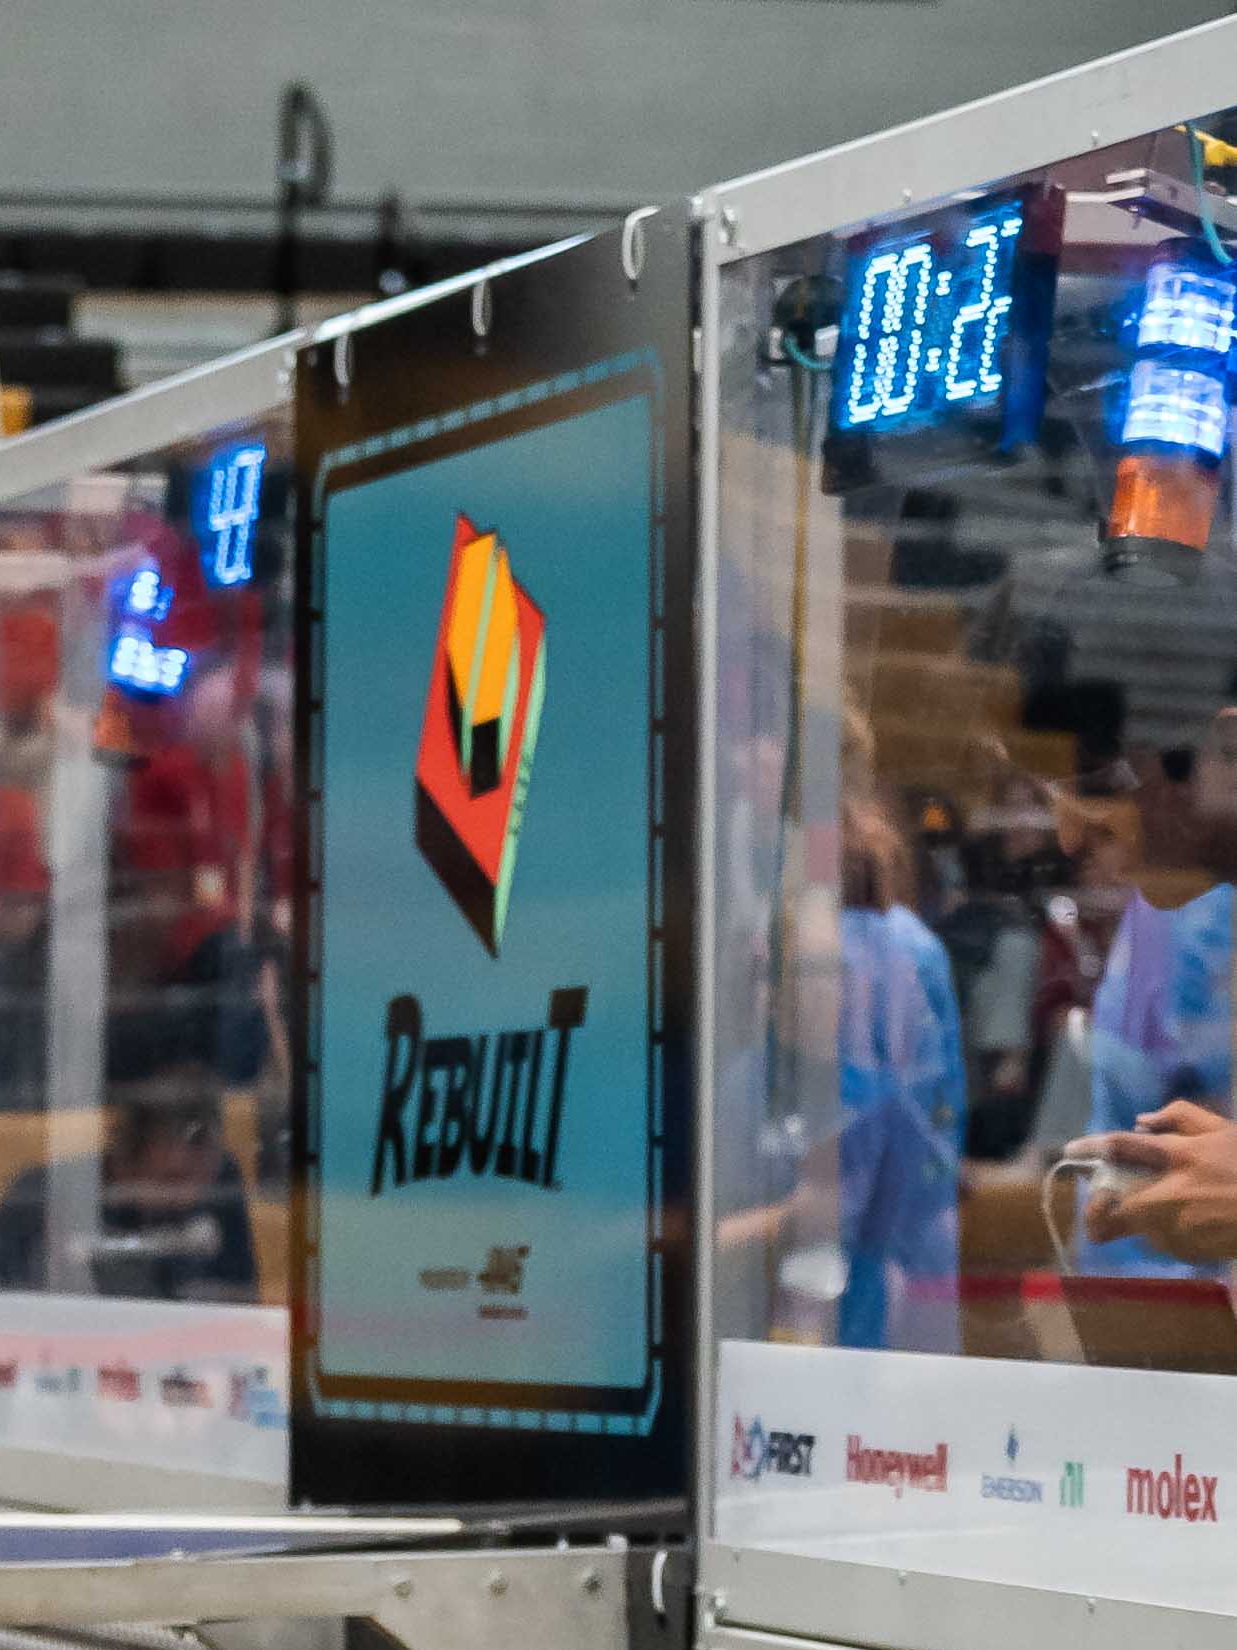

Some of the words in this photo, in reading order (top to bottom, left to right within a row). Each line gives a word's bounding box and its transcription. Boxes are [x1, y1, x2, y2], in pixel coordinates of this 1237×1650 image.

[370, 986, 588, 1198] REBUILT
[847, 1434, 949, 1498] Honeywell
[1126, 1453, 1218, 1522] molex
